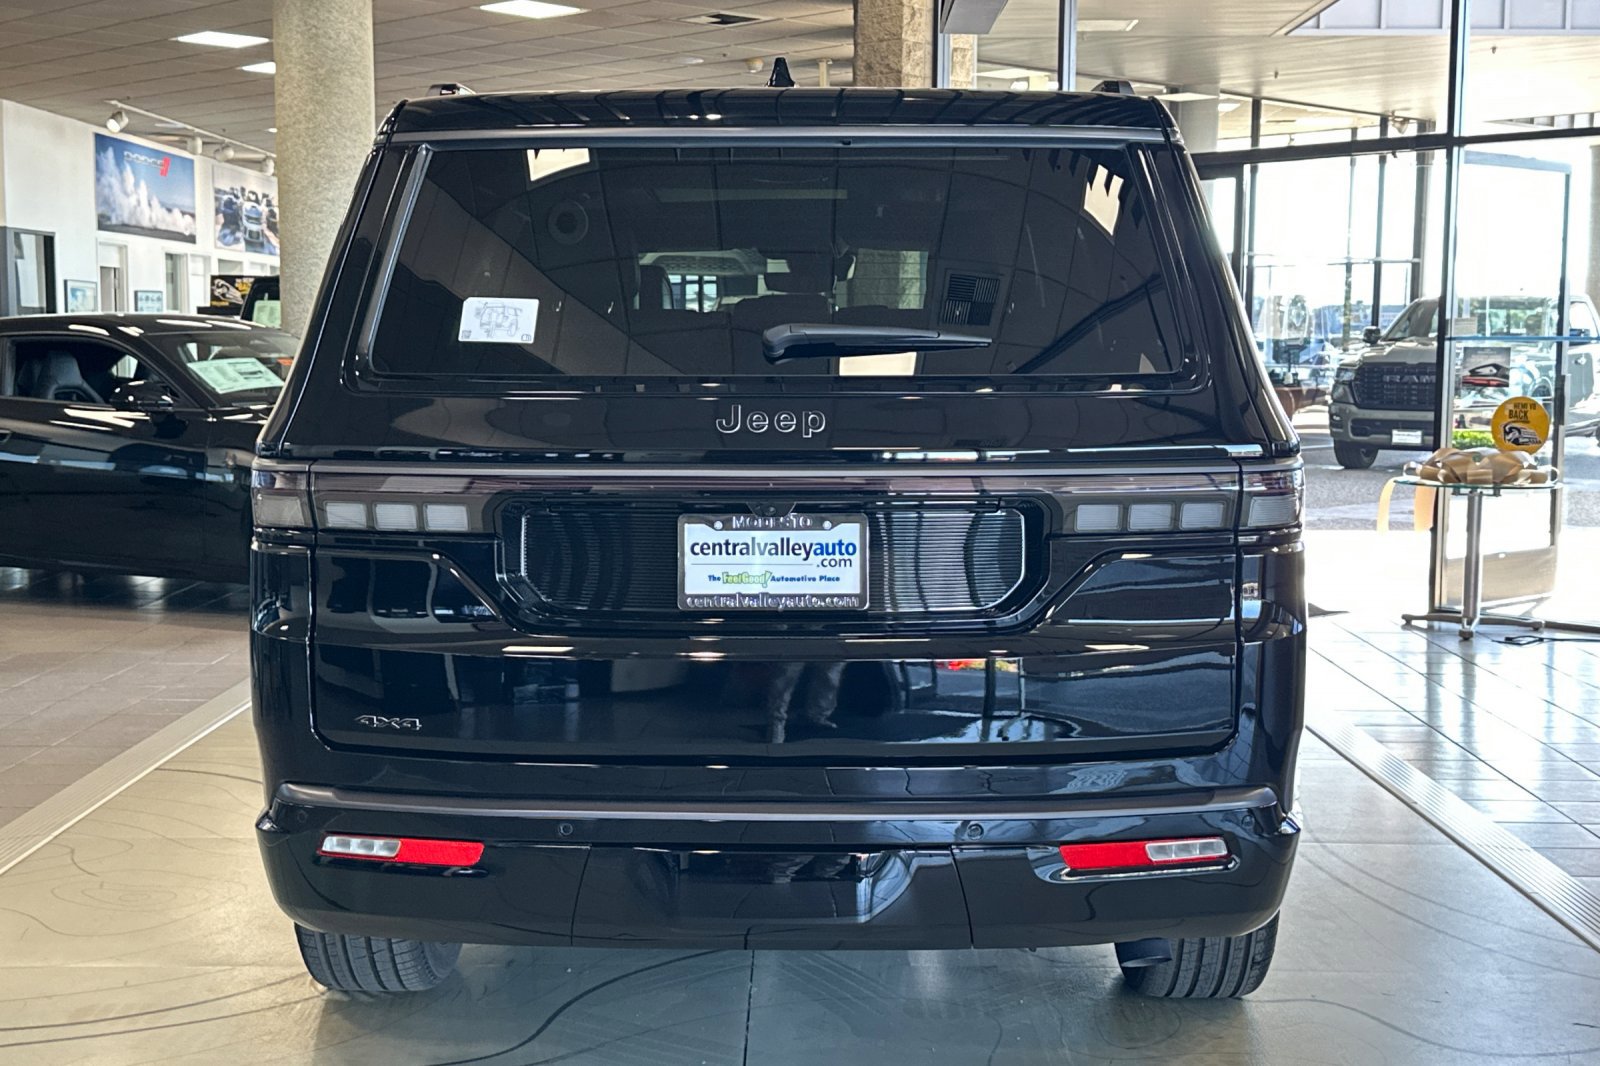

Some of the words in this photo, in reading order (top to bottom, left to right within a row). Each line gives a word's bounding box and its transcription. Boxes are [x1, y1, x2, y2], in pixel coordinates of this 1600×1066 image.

[1382, 374, 1436, 384] RAM
[1508, 409, 1529, 419] BACK
[715, 404, 826, 438] Jeep
[690, 537, 857, 561] centralvalleyauto
[816, 557, 853, 568] .com
[708, 574, 721, 582] The
[819, 574, 840, 582] Place
